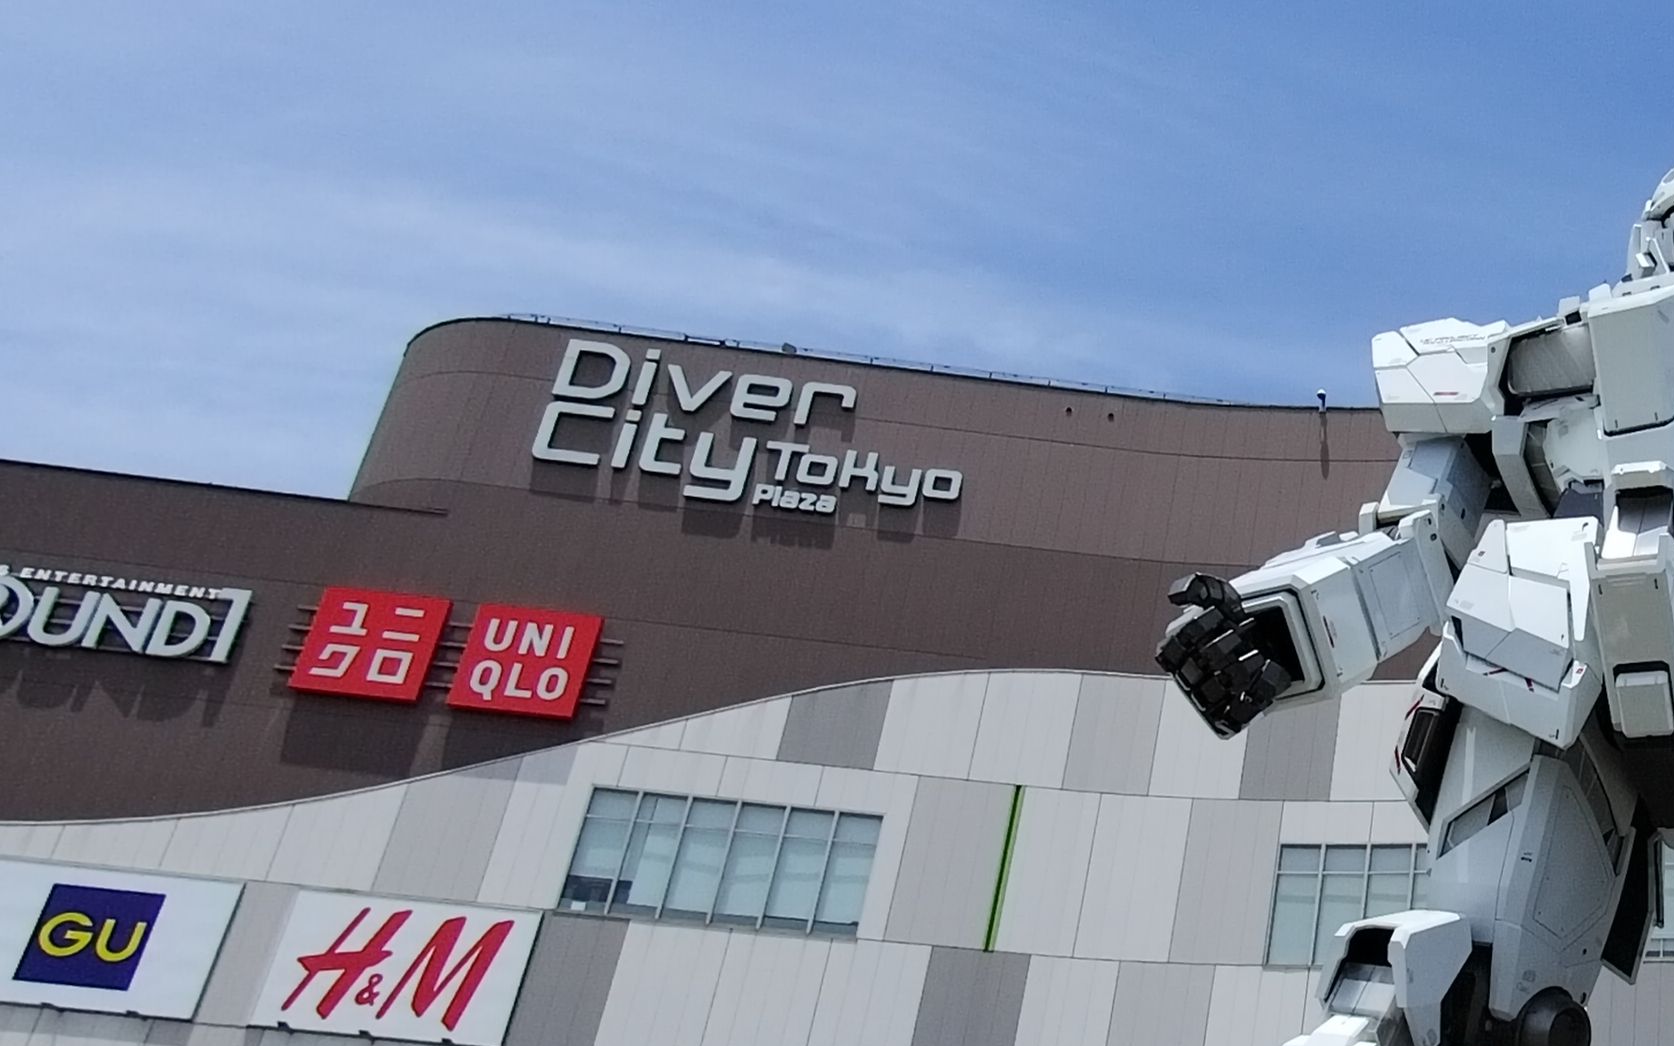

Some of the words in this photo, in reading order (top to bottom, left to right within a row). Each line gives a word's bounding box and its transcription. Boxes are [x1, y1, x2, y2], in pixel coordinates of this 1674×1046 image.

[551, 338, 857, 425] Diver
[531, 400, 758, 501] City
[751, 483, 838, 514] Plaza
[20, 566, 222, 600] ENTERTAINMENT
[329, 602, 425, 642] ユニ
[484, 617, 575, 659] UNI
[308, 643, 413, 684] クロ
[469, 659, 569, 701] QLO
[37, 912, 147, 962] GU
[281, 907, 514, 1031] H&M
